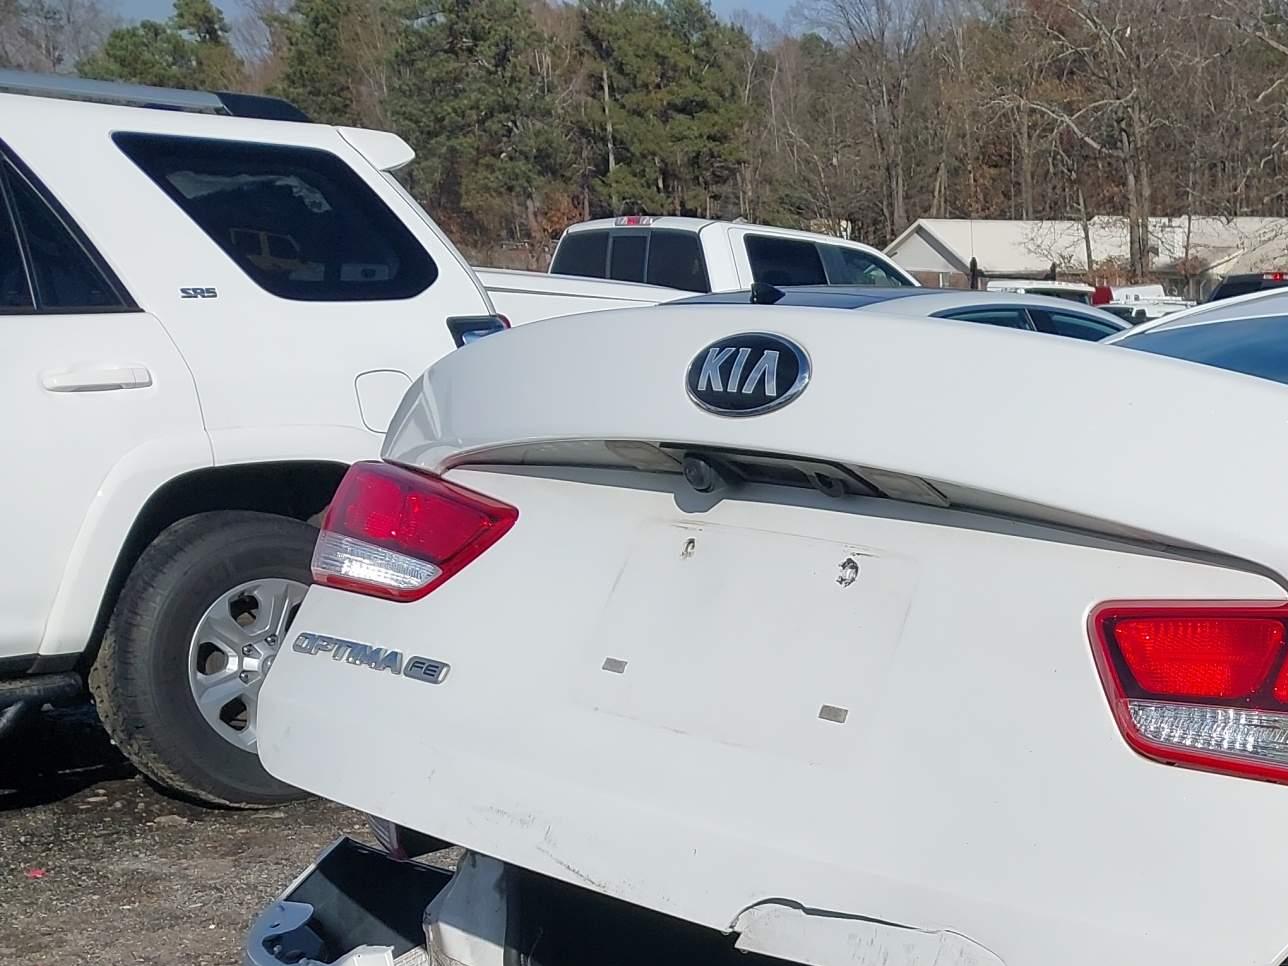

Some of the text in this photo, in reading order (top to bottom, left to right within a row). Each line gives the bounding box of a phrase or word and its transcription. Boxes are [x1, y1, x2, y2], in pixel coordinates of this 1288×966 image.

[179, 287, 218, 299] SR5
[697, 347, 780, 397] KIA
[292, 631, 442, 680] OPTIMA FE
